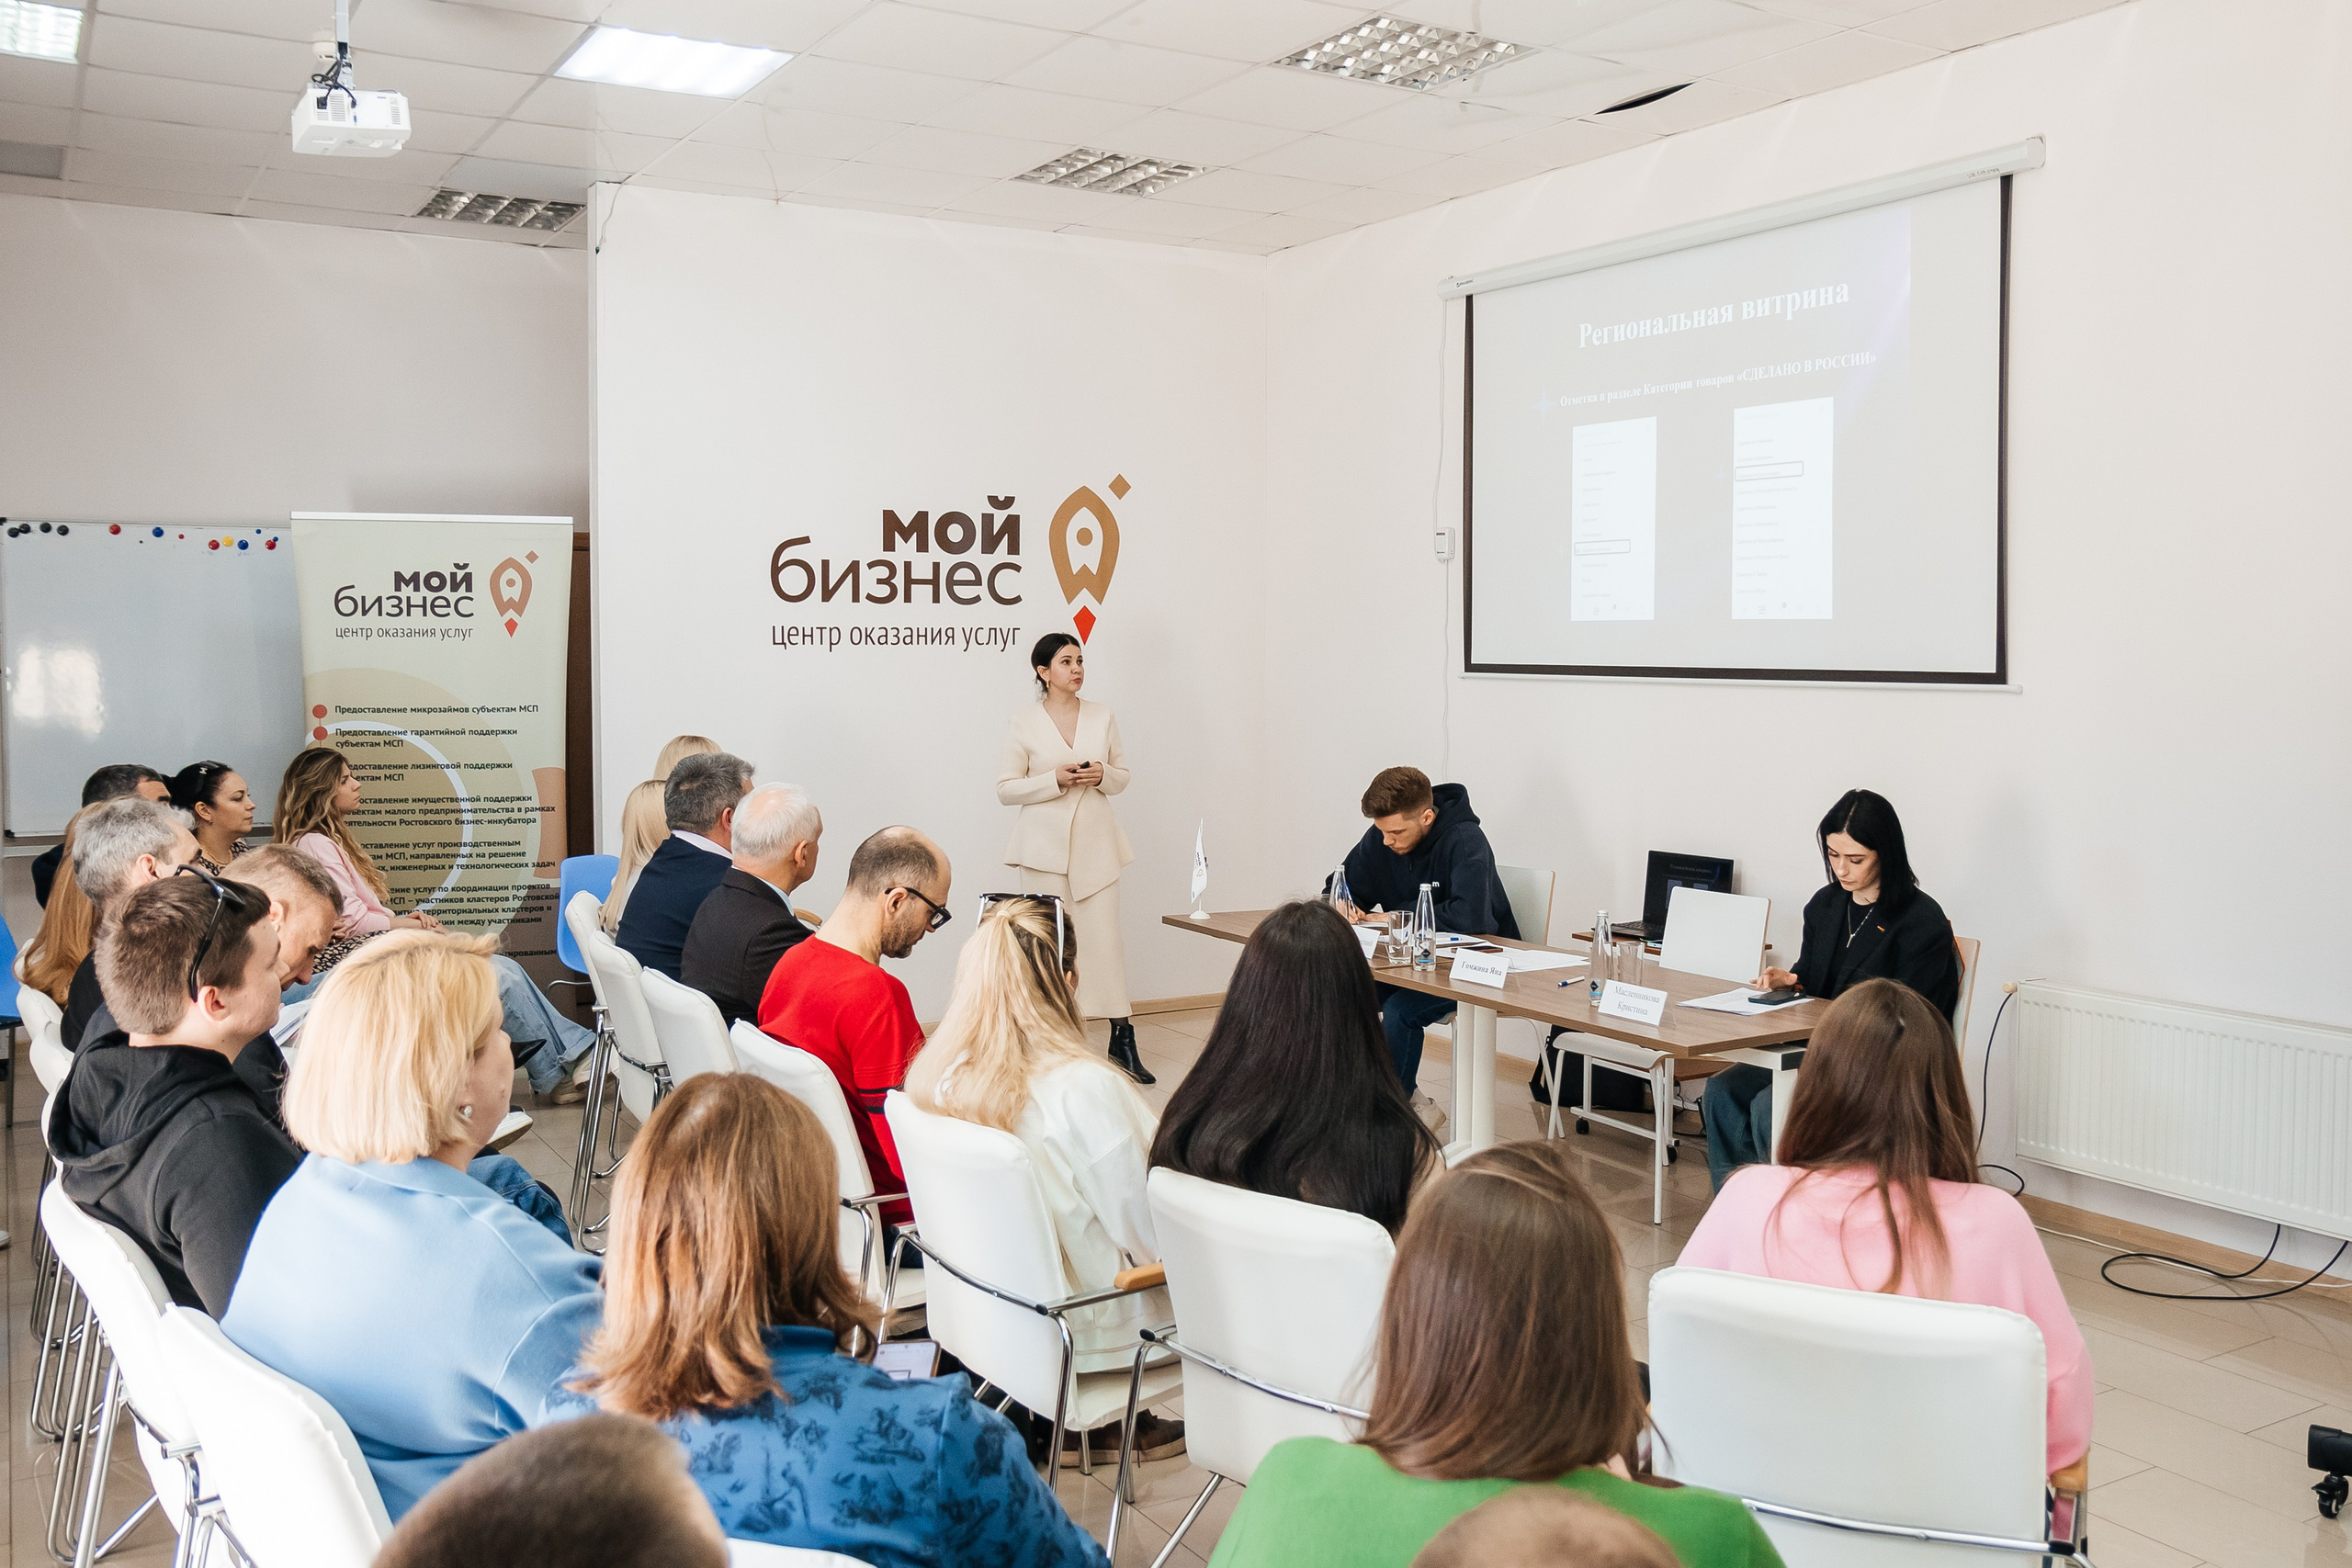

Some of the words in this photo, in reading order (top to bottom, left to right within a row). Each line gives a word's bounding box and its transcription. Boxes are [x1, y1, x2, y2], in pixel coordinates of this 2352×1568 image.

[1578, 303, 1734, 348] Региональная
[1741, 282, 1849, 321] витрина
[1560, 392, 1598, 407] Отметка
[1600, 392, 1605, 401] в
[1607, 389, 1642, 403] разделе
[1643, 379, 1693, 396] Категории
[1695, 373, 1735, 389] товаров
[1736, 361, 1801, 381] «СДЕЛАНО
[1804, 359, 1813, 373] В
[1815, 351, 1877, 371] РОССИИ»
[882, 495, 1021, 556] мой
[770, 535, 1023, 606] бизнес
[394, 562, 473, 592] мой
[334, 584, 475, 618] бизнес
[335, 626, 373, 641] центр
[377, 626, 436, 638] оказания
[439, 626, 474, 641] услуг
[772, 625, 842, 653] центр
[849, 626, 956, 647] оказания
[963, 626, 1021, 653] услуг
[334, 705, 408, 716] Предоставление
[410, 705, 469, 716] микрозаймов
[471, 705, 517, 715] субъектам
[518, 705, 539, 713] МСП
[335, 728, 408, 738] Предоставление
[410, 728, 466, 738] гарантийной
[468, 728, 518, 737] поддержки
[335, 739, 381, 750] субъектам
[383, 739, 404, 748] МСП
[410, 761, 461, 771] лизинговой
[463, 762, 514, 771] поддержки
[384, 773, 404, 782] МСП
[412, 795, 481, 805] имущественной
[483, 795, 533, 804] поддержки
[418, 807, 514, 817] предпринимательства
[525, 806, 556, 815] рамках
[399, 818, 453, 827] Ростовского
[454, 817, 537, 827] бизнес-инкубатора
[412, 841, 435, 851] услуг
[437, 840, 521, 851] производственным
[385, 852, 408, 861] МСП,
[410, 852, 474, 861] направленных
[488, 851, 526, 860] решение
[390, 863, 446, 872] инженерных
[456, 863, 529, 871] технологических
[413, 886, 436, 895] услуг
[451, 884, 509, 894] координации
[511, 883, 551, 892] проектов
[415, 897, 464, 906] участников
[466, 896, 510, 904] кластеров
[512, 893, 560, 901] Ростовской
[423, 907, 500, 916] территориальных
[502, 905, 545, 913] кластеров
[487, 917, 542, 926] участниками
[1489, 967, 1502, 976] Яна
[1617, 1001, 1648, 1016] Кристина
